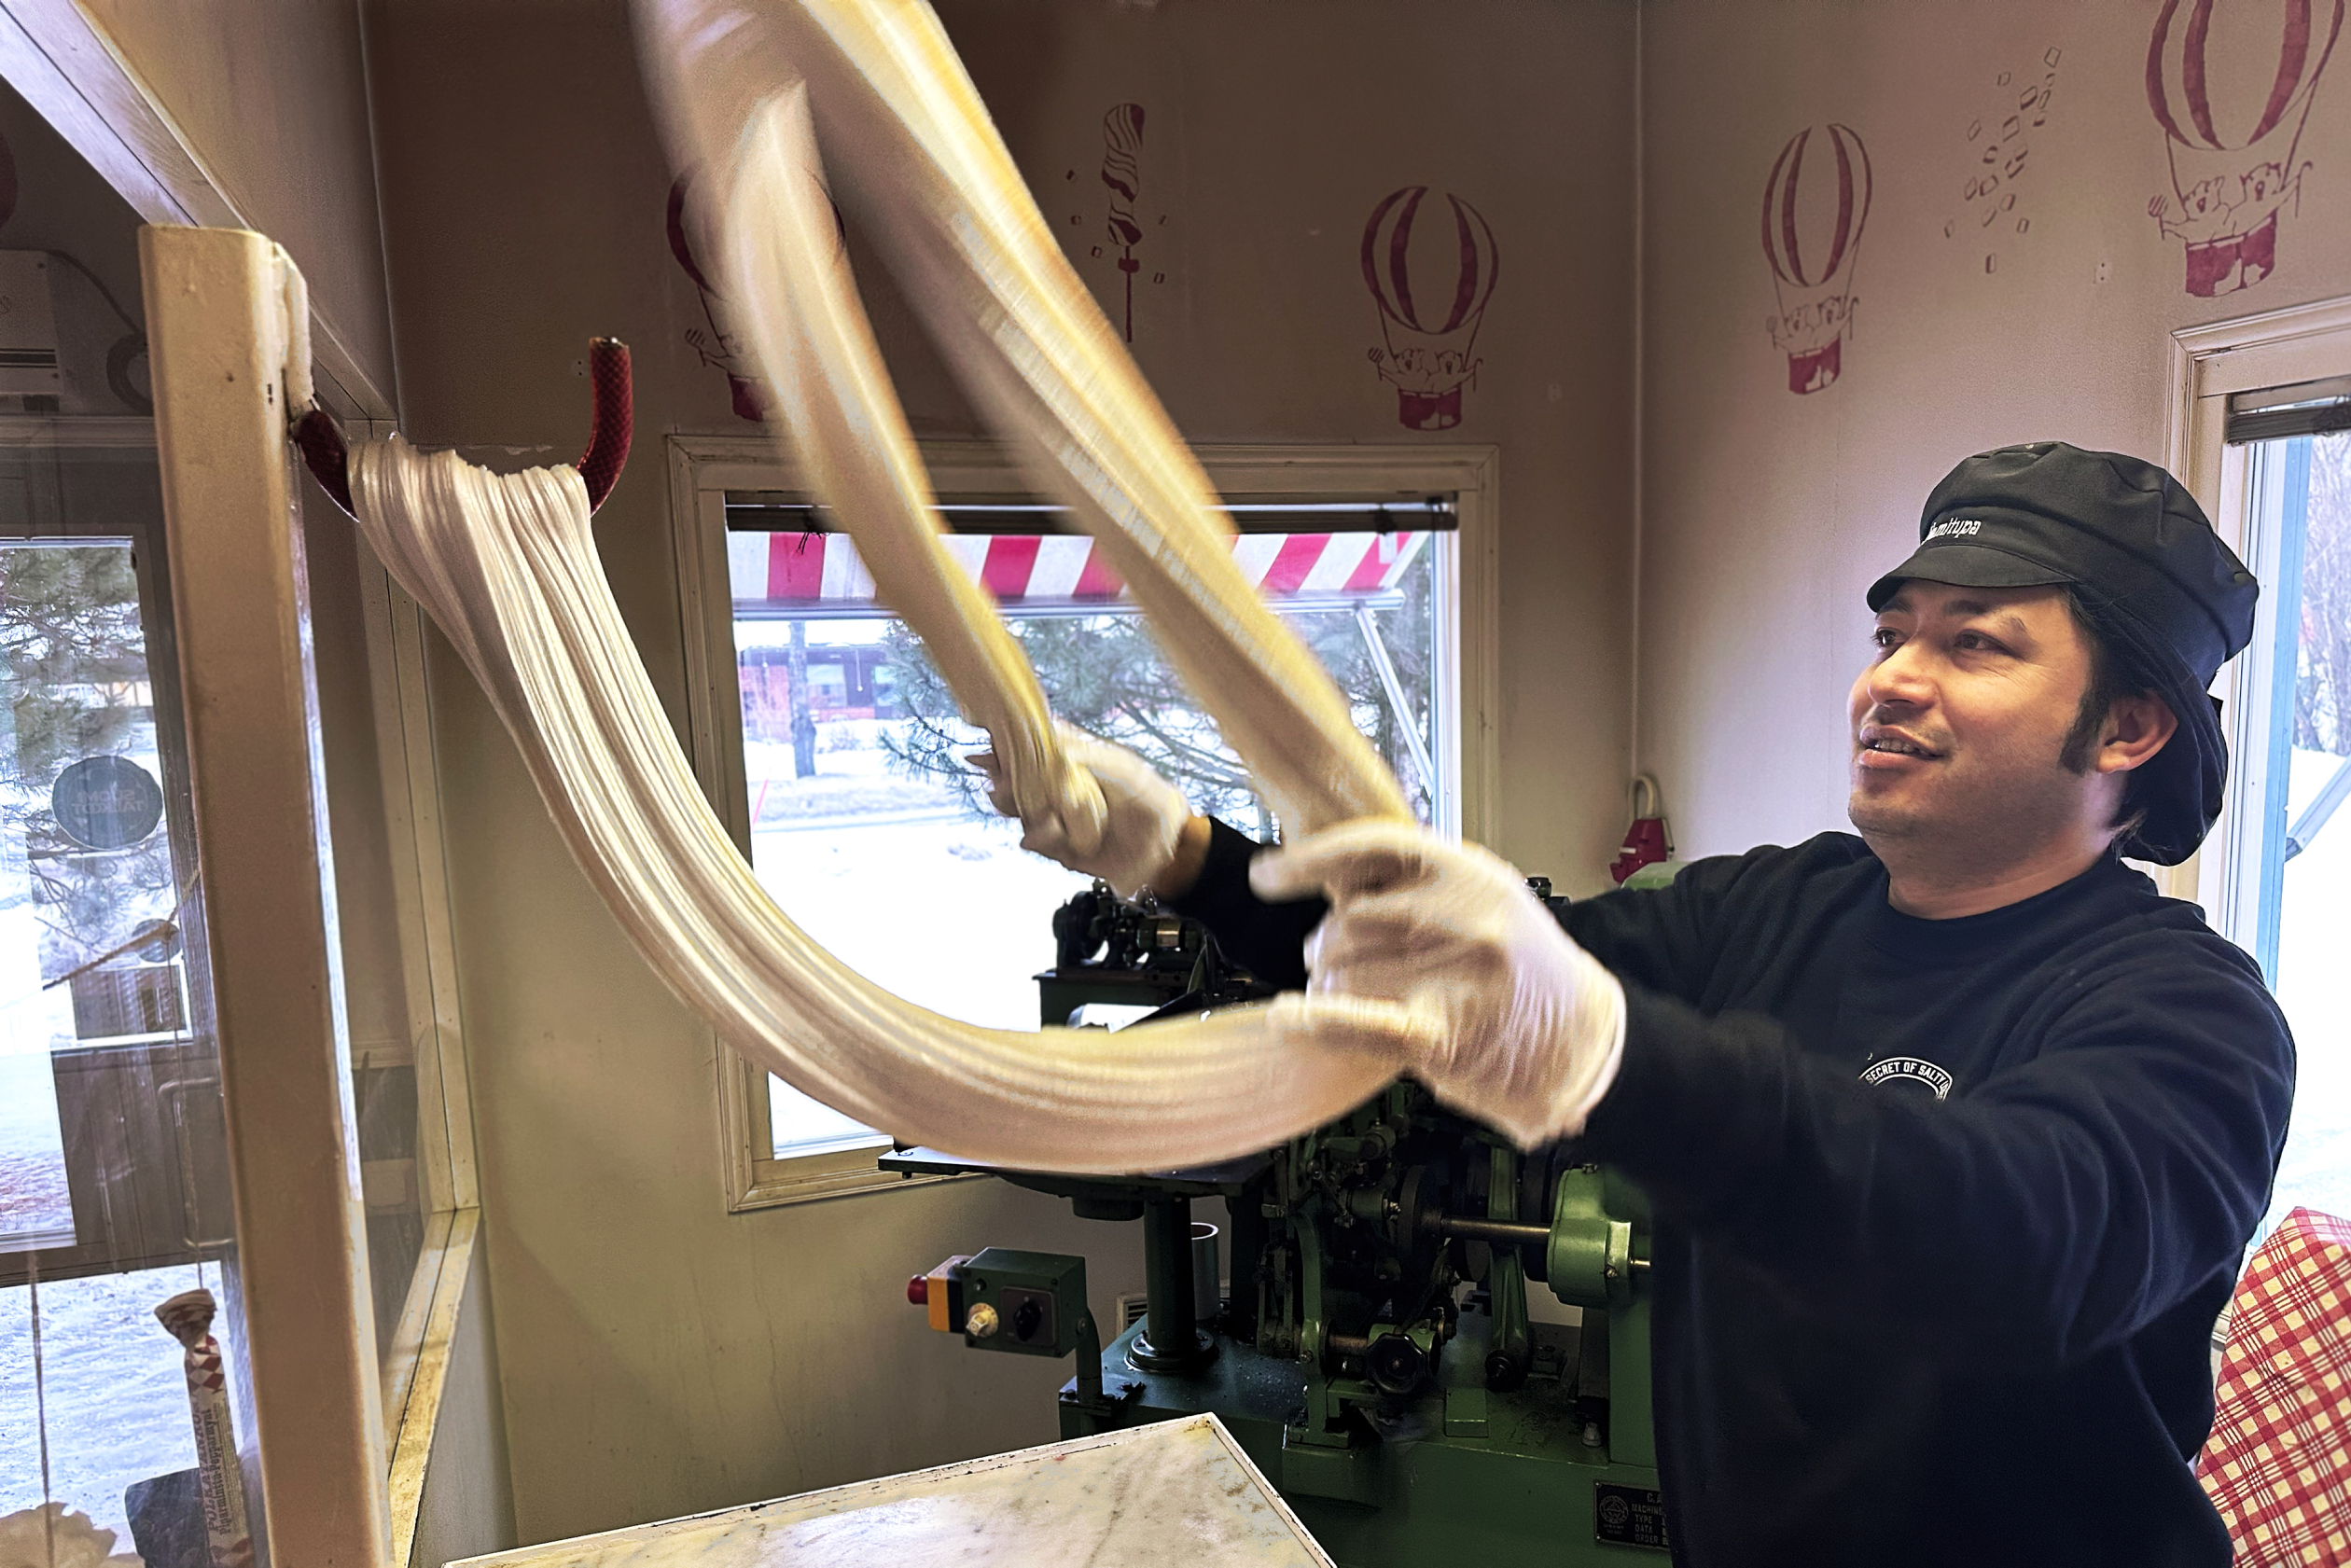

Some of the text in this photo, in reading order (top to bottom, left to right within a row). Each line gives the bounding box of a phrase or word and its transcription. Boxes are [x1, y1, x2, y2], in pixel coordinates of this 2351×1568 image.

[1865, 1062, 1946, 1085] SECRET OF SALTY
[1635, 1513, 1652, 1524] TYPE
